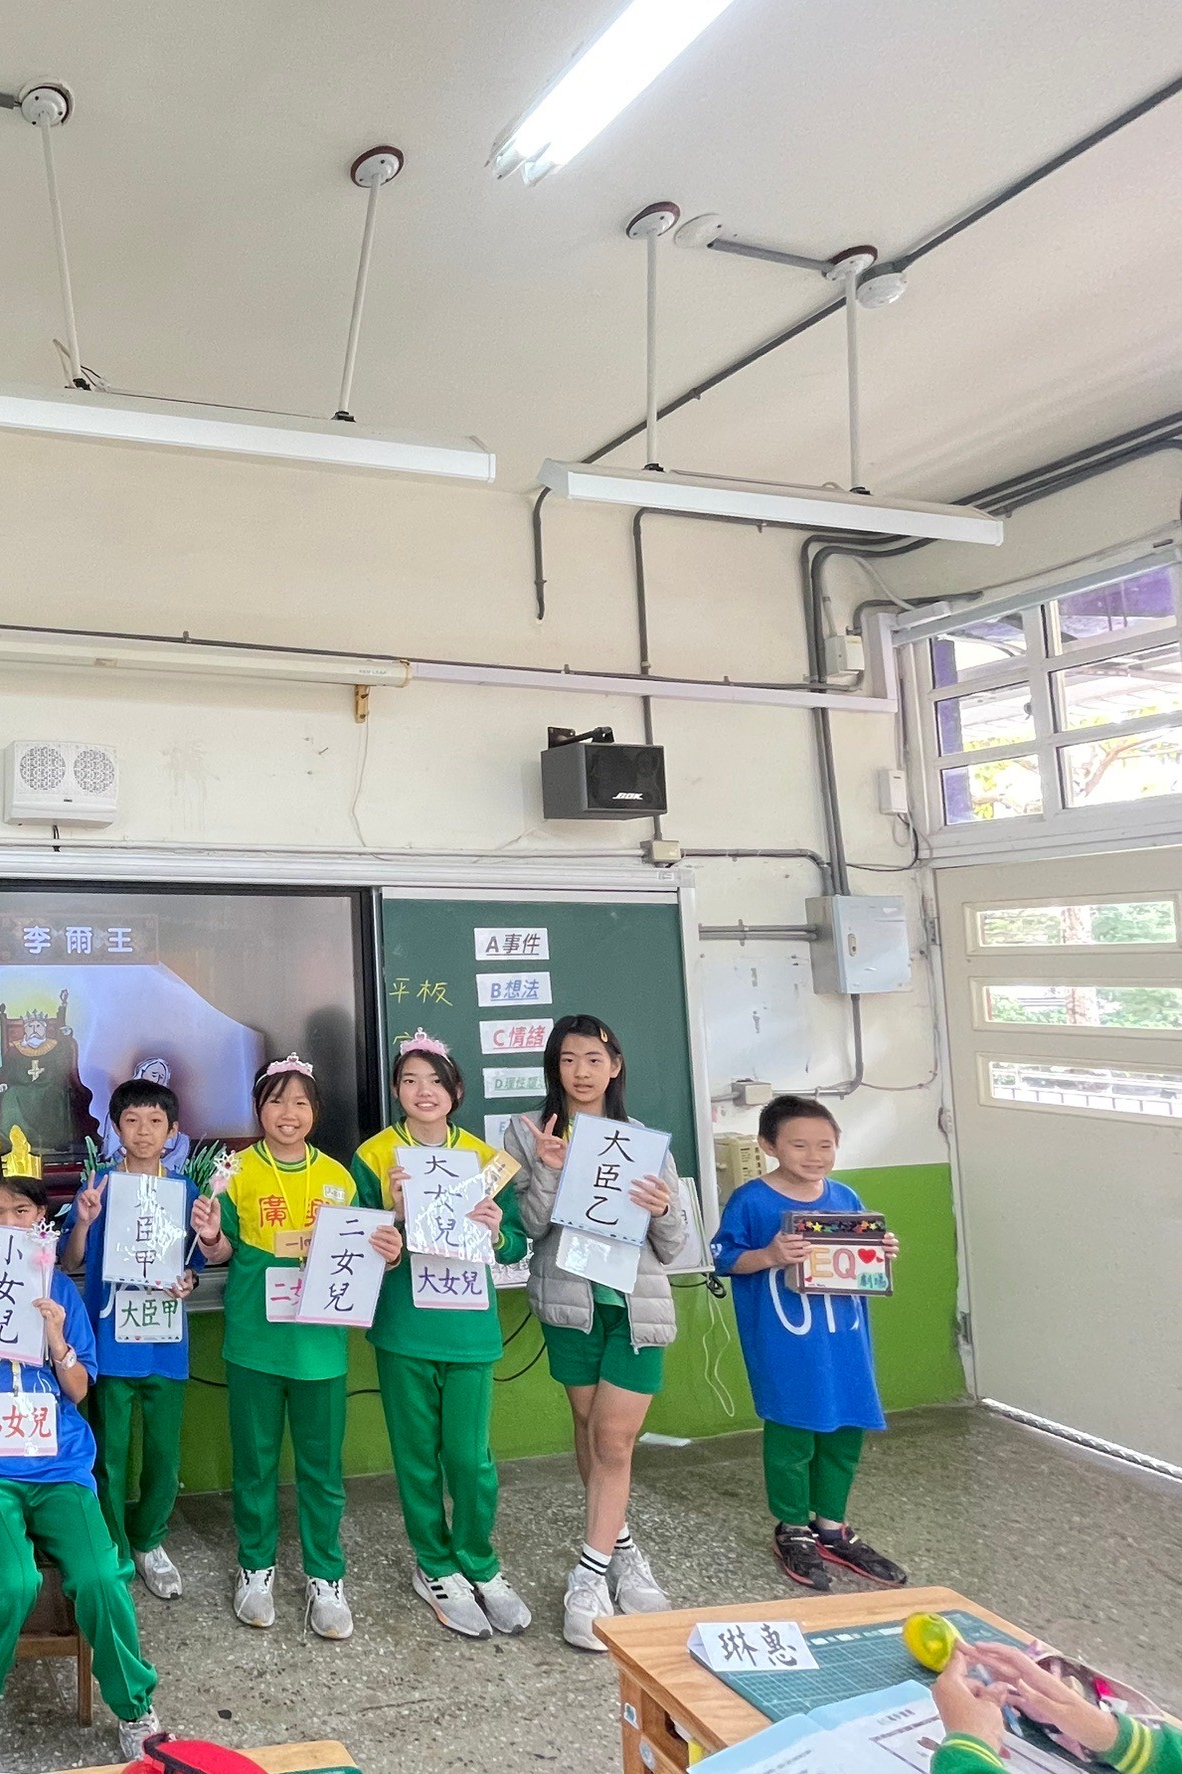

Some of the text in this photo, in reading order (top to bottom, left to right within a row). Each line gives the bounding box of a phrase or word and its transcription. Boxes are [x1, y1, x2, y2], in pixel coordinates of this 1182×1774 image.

[23, 925, 133, 954] 李爾王
[389, 977, 453, 1006] 平板
[585, 1130, 635, 1226] 大臣乙
[324, 1218, 365, 1312] 二女兒
[809, 1246, 857, 1280] EQ
[418, 1266, 483, 1296] 大女兒
[119, 1298, 179, 1329] 大臣甲
